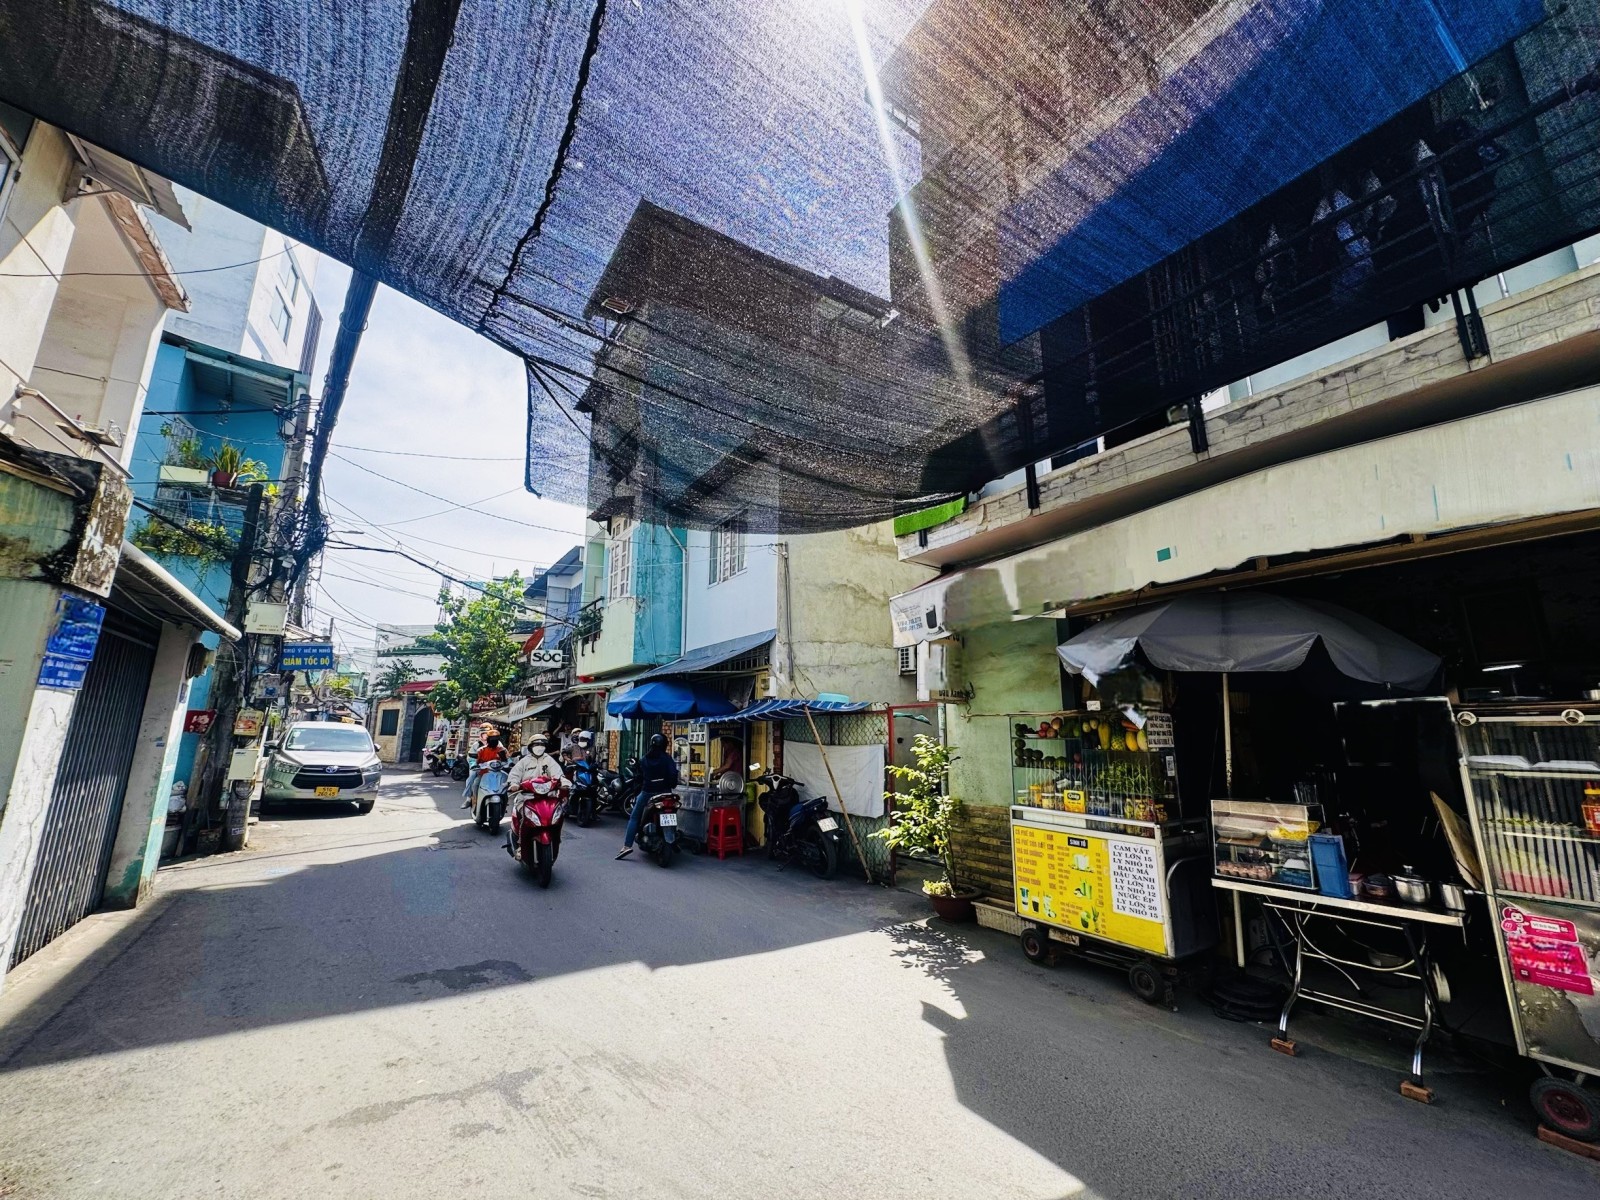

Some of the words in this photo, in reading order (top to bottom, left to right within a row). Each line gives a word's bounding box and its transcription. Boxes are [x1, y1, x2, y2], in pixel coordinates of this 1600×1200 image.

[283, 655, 301, 665] GIẢM
[304, 655, 318, 665] TỐC
[320, 656, 330, 666] ĐỘ
[1125, 859, 1142, 867] NHỎ
[1137, 867, 1149, 876] MÁ
[1132, 874, 1155, 884] XANH
[1128, 886, 1145, 894] NHỎ
[1118, 891, 1141, 900] NƯỚC
[1129, 900, 1146, 909] LỚN
[1129, 906, 1147, 915] NHỎ
